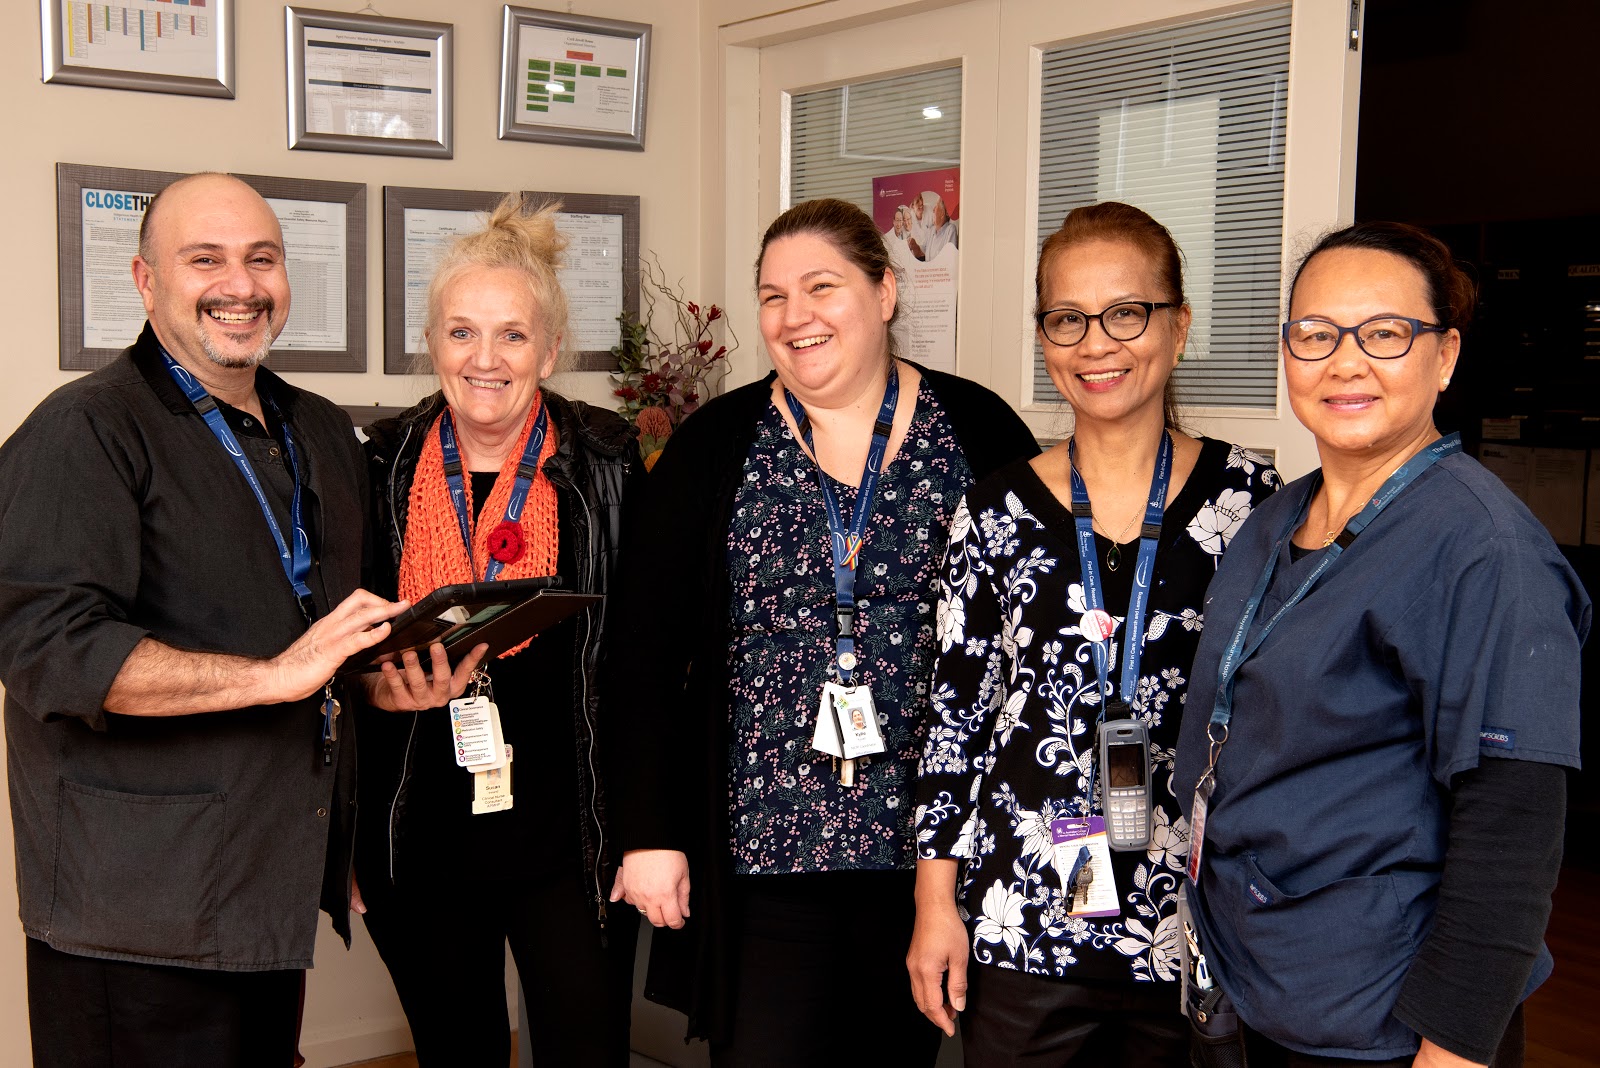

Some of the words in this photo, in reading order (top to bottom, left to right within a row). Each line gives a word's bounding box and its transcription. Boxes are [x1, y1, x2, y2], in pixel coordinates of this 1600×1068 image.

[86, 192, 154, 211] CLOSETH
[1309, 558, 1328, 580] Hospital
[1239, 615, 1248, 630] Royal
[1227, 630, 1242, 660] Melbourne
